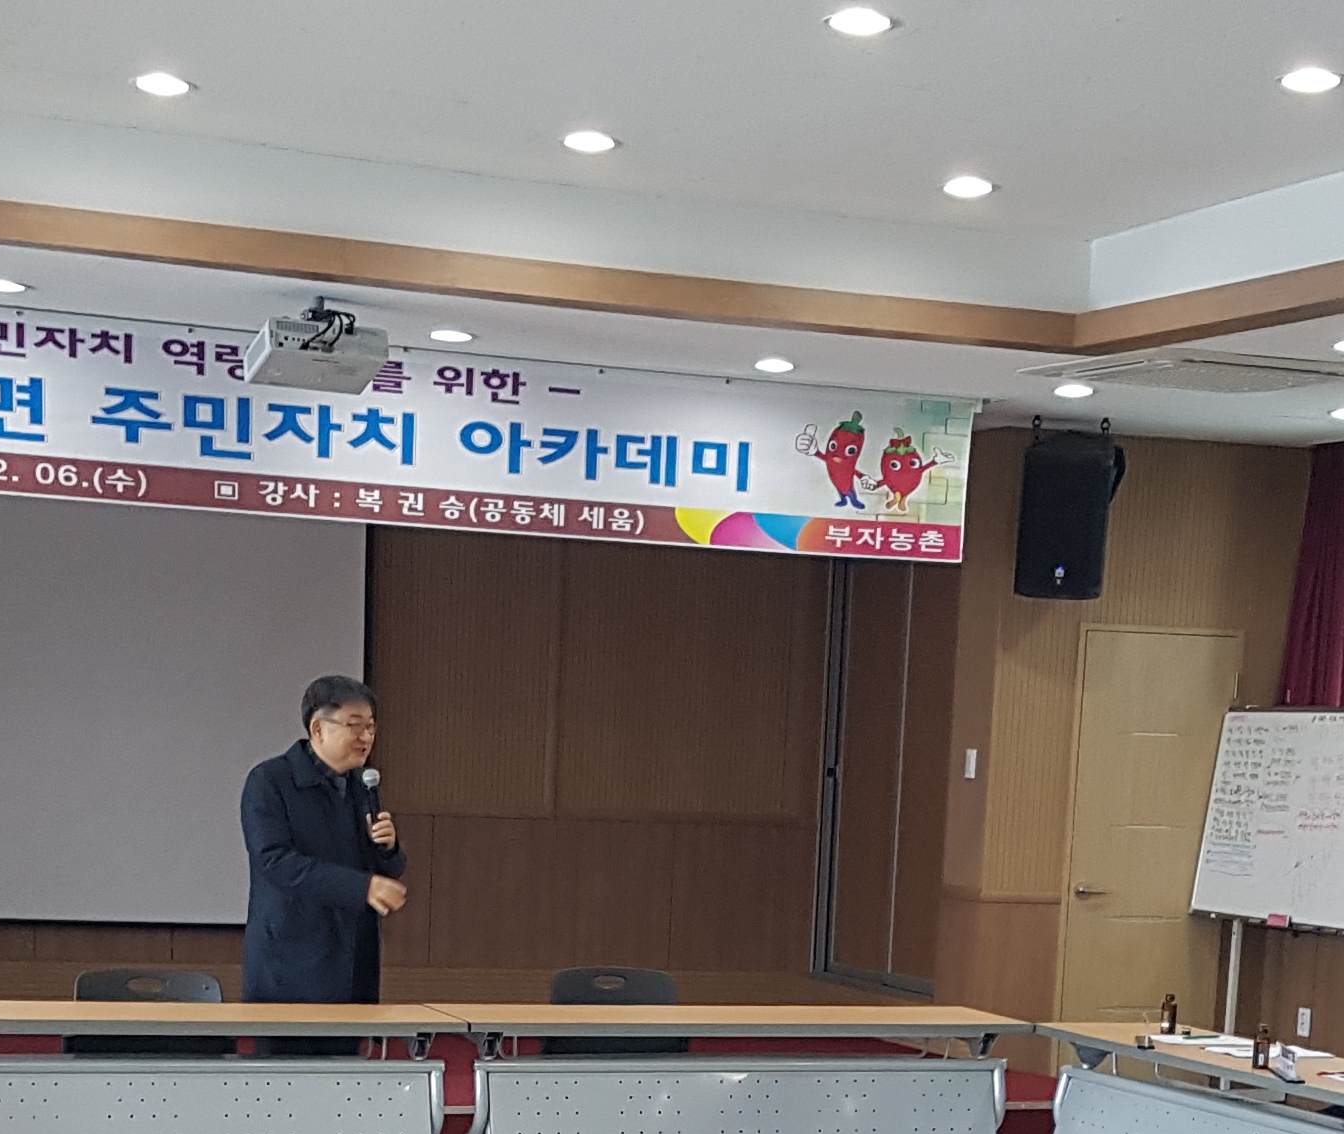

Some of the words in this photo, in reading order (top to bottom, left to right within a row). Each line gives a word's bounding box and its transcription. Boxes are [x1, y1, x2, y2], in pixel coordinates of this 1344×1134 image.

[432, 365, 527, 405] 위한
[90, 386, 417, 466] 주민자치
[458, 420, 751, 493] 아카데미
[34, 461, 149, 498] 06.(수)
[258, 479, 320, 508] 강사
[577, 504, 646, 535] 세움)
[824, 524, 946, 555] 부자농촌
